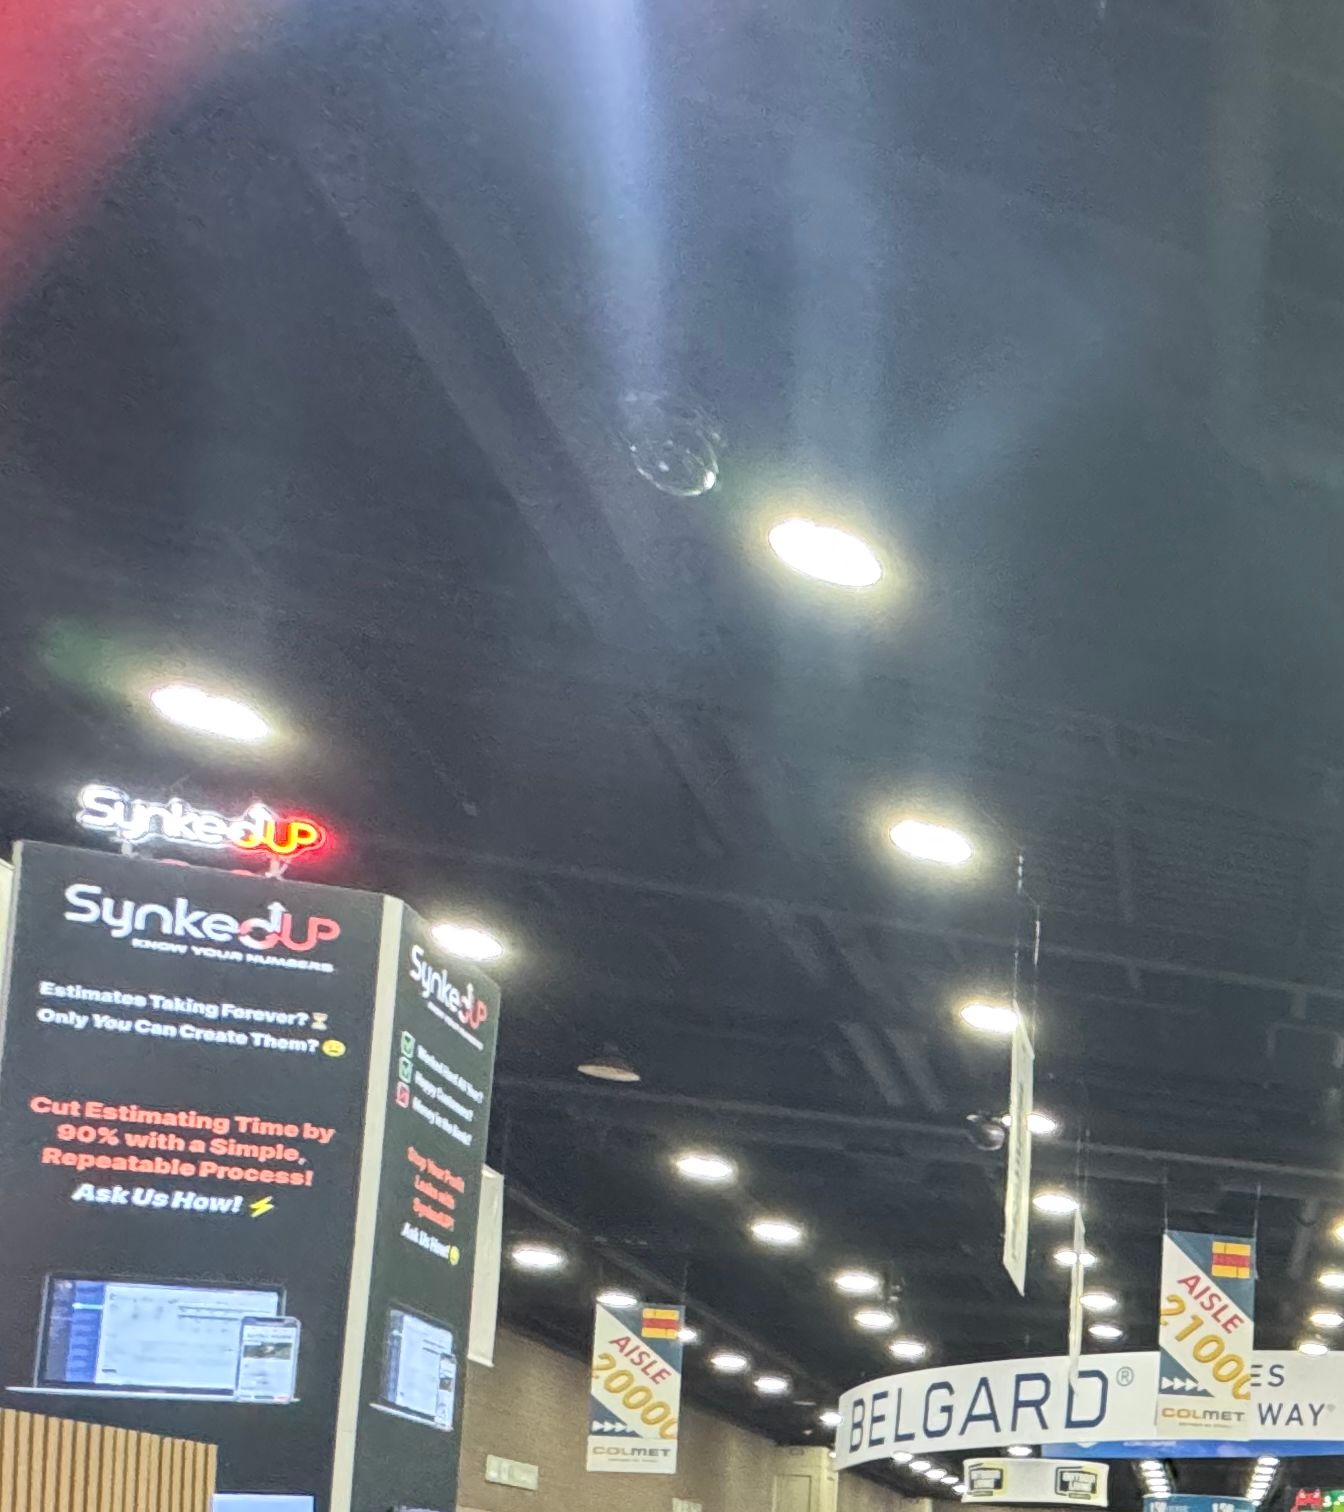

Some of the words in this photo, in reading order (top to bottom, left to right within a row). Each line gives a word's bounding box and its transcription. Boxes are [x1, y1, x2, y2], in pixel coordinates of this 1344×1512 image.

[39, 981, 147, 1007] Estimates
[149, 993, 219, 1020] Taking
[222, 1004, 310, 1026] Forever?
[36, 1008, 89, 1029] Only
[92, 1013, 132, 1032] You
[134, 1019, 177, 1038] Can
[179, 1024, 249, 1046] Create
[249, 1032, 320, 1054] Them?
[30, 1096, 81, 1117] Cut
[84, 1101, 230, 1134] Estimating
[234, 1115, 300, 1138] Time
[302, 1122, 336, 1144] by
[56, 1123, 120, 1147] 90%
[124, 1130, 186, 1152] with
[189, 1137, 206, 1154] a
[209, 1138, 307, 1165] Simple,
[40, 1147, 196, 1177] Repeatable
[199, 1160, 314, 1187] Process!
[70, 1182, 130, 1205] Ask
[131, 1186, 169, 1208] Us
[170, 1190, 244, 1214] How!
[1177, 1274, 1245, 1335] AISLE
[609, 1336, 672, 1385] AISLE
[1251, 1364, 1285, 1388] ES
[1161, 1407, 1246, 1422] COLMET
[592, 1446, 672, 1457] COLMET
